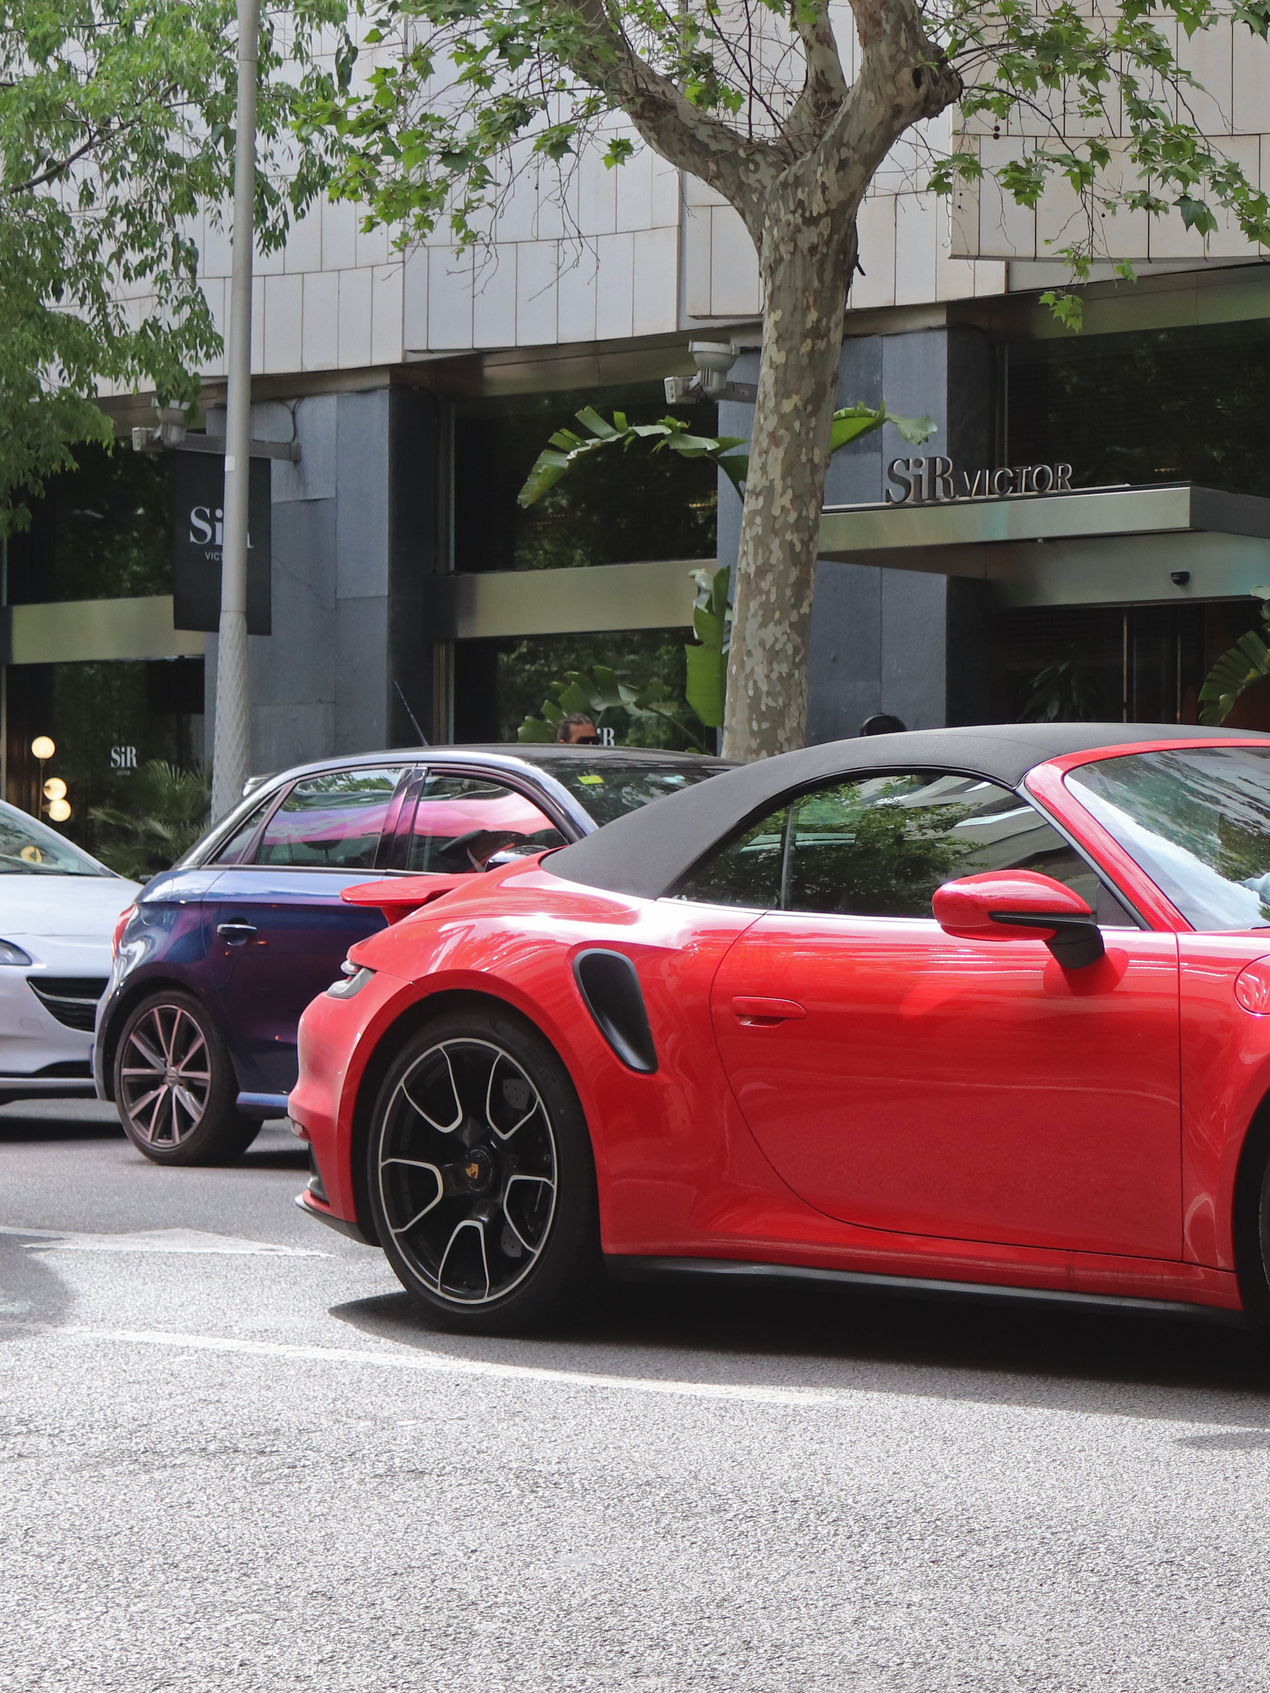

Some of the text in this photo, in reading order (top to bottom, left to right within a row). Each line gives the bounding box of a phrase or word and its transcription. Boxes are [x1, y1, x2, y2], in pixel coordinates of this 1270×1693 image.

[886, 456, 1073, 504] SiR VICTOR
[110, 745, 138, 768] SiR
